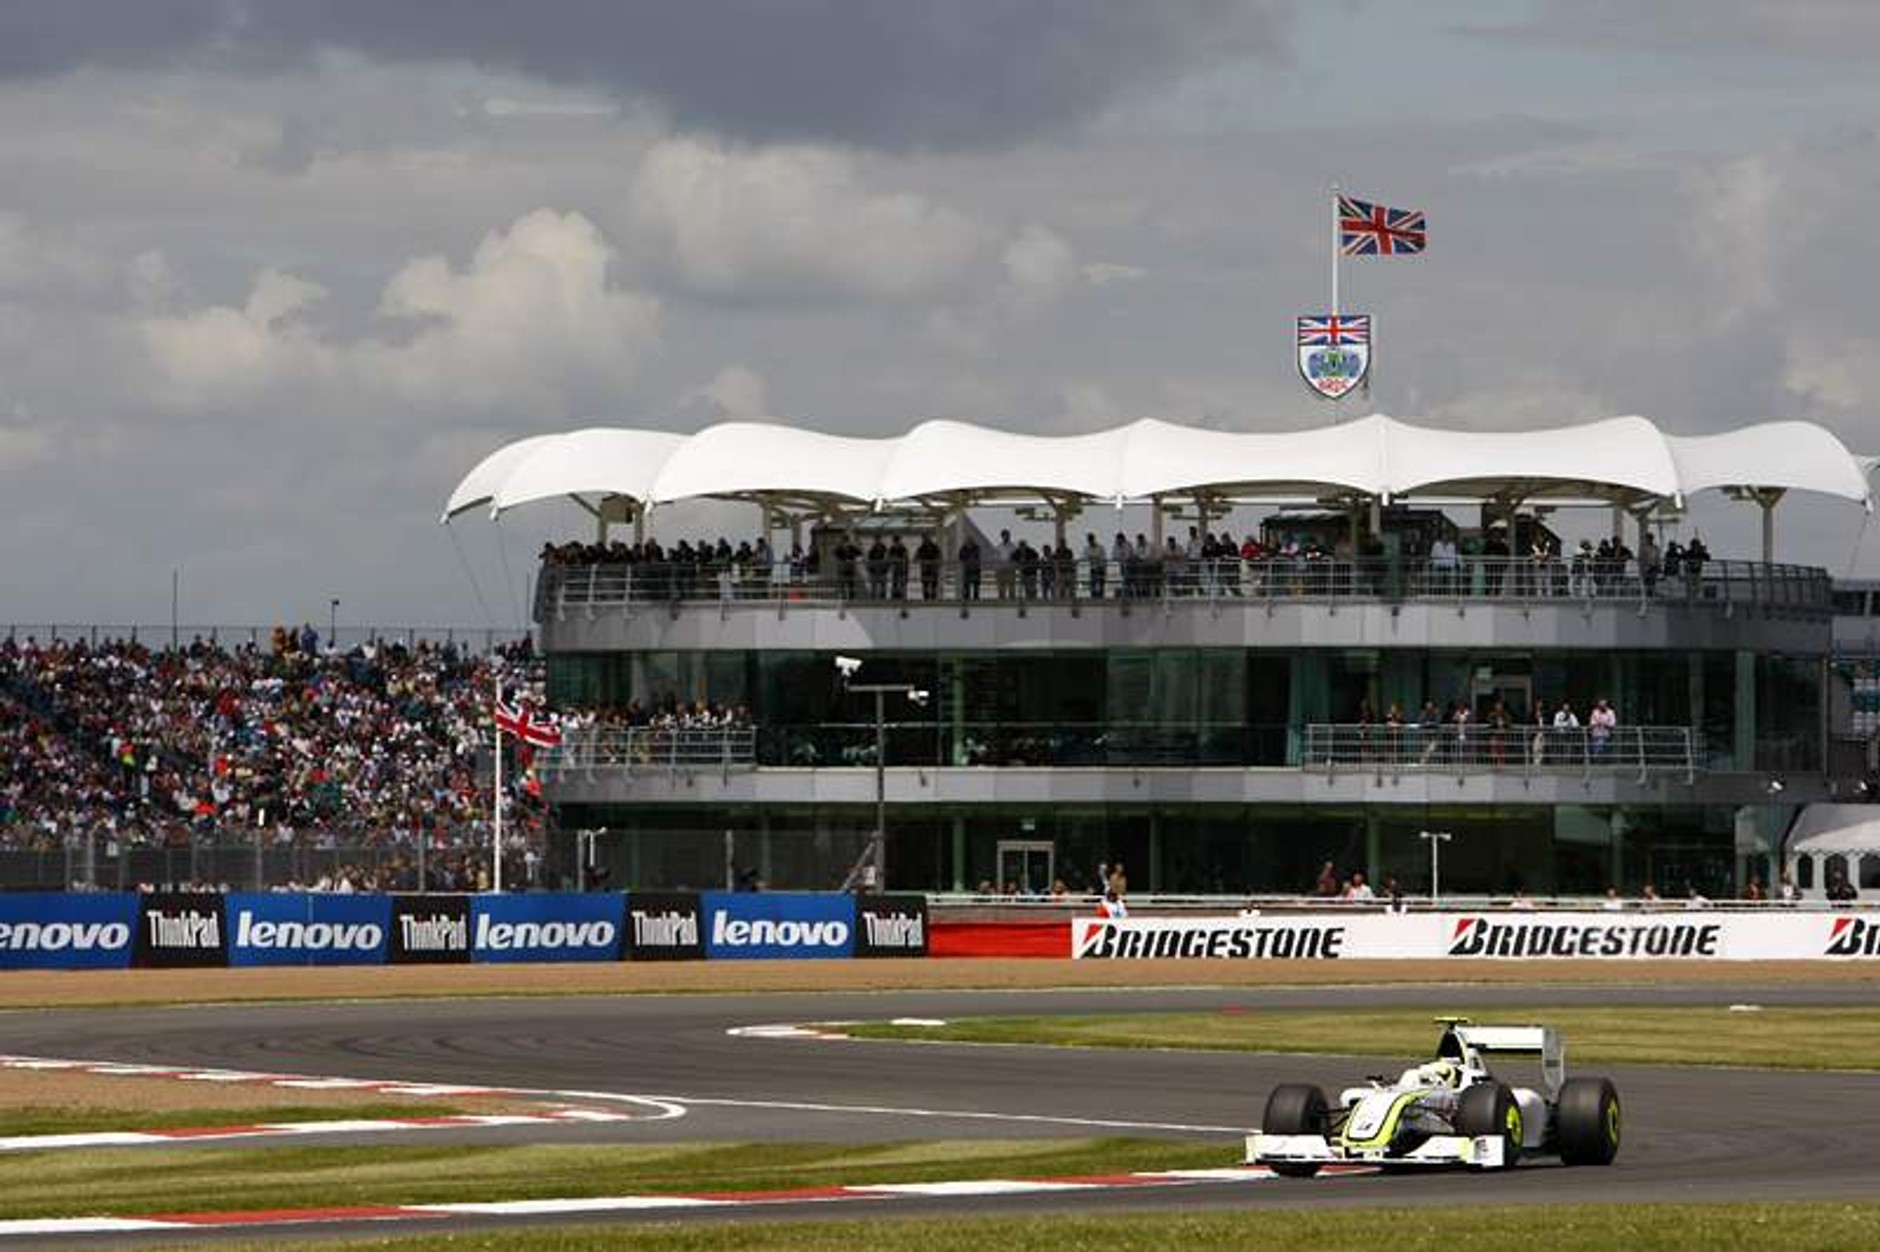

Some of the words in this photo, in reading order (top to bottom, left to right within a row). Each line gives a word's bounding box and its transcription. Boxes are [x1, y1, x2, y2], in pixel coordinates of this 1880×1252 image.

[148, 911, 219, 948] ThinkPad
[237, 912, 382, 949] lenovo
[400, 914, 468, 950] ThinkPad
[475, 914, 615, 949] lenovo
[632, 910, 698, 946] ThinkPad
[712, 910, 848, 946] lenovo
[862, 911, 924, 946] ThinkPad
[1081, 922, 1346, 958] BRIDGESTONE
[1448, 918, 1721, 956] BRIDGESTONE
